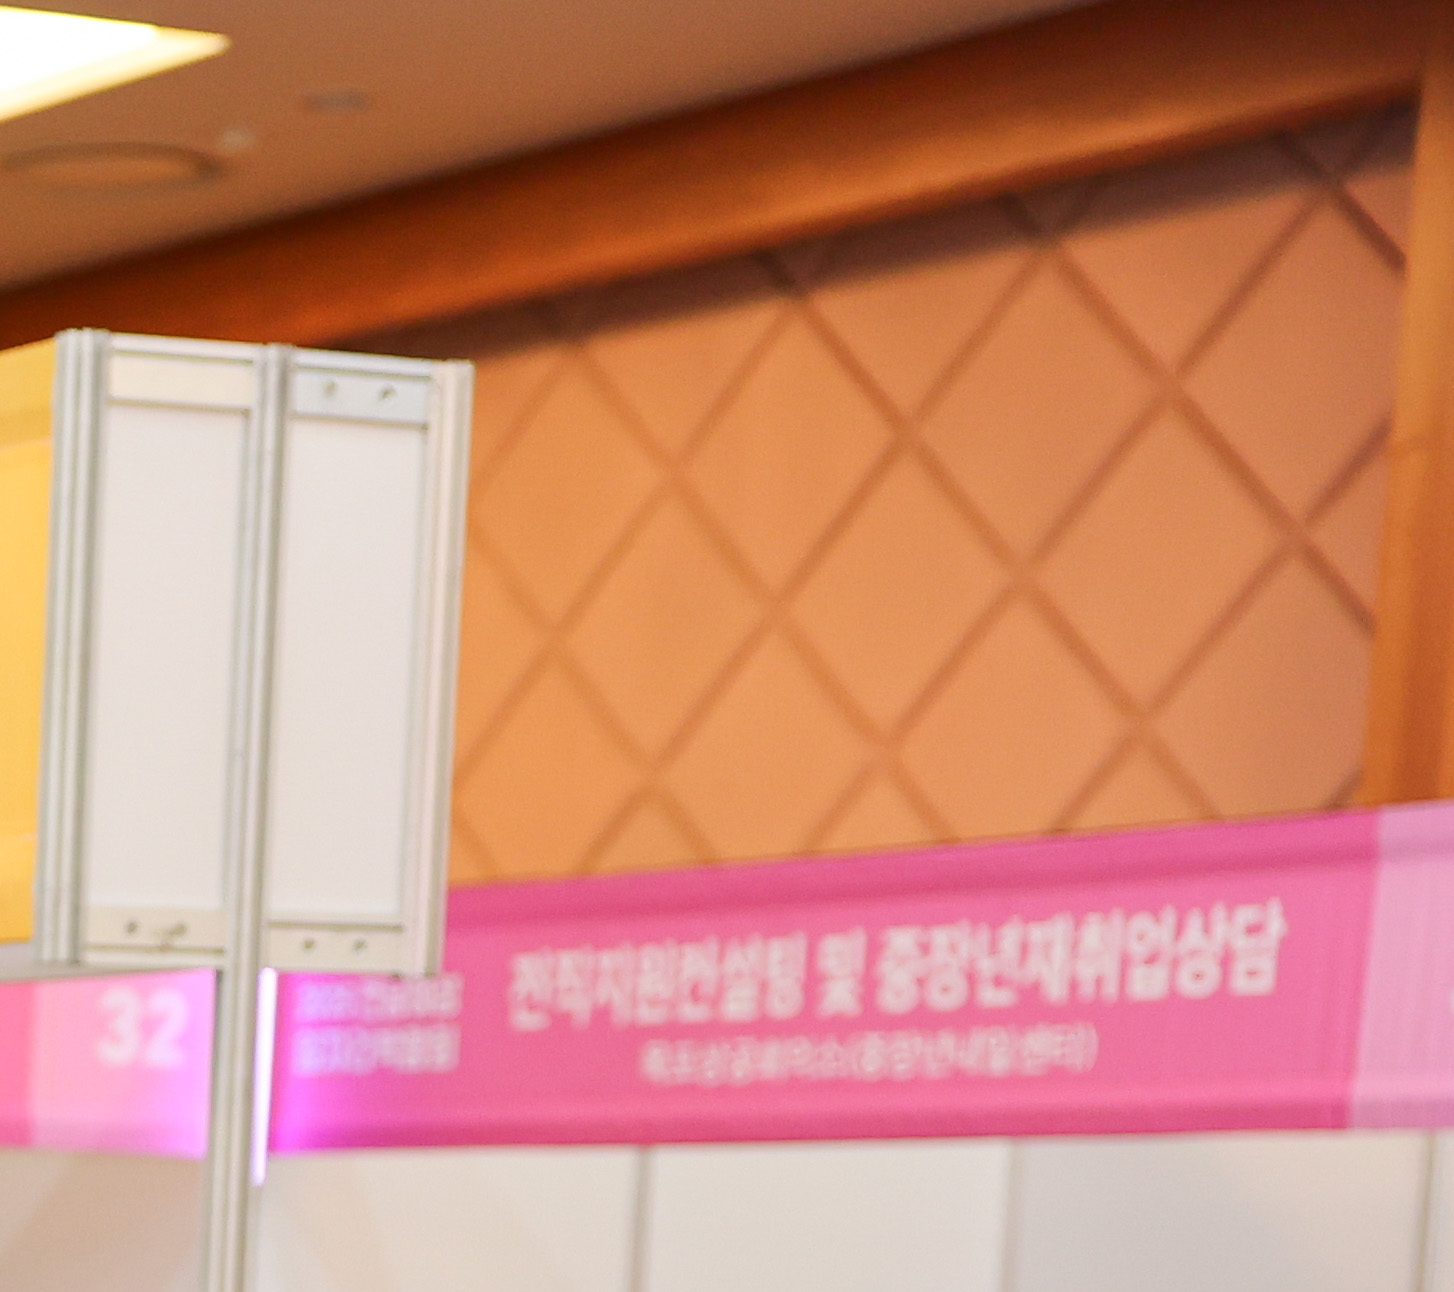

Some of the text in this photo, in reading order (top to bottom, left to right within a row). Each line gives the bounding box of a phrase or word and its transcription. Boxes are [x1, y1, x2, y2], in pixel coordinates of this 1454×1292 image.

[509, 897, 1286, 1031] 전직지원컨설팅 및 중장년재취업상담
[96, 988, 188, 1068] 32
